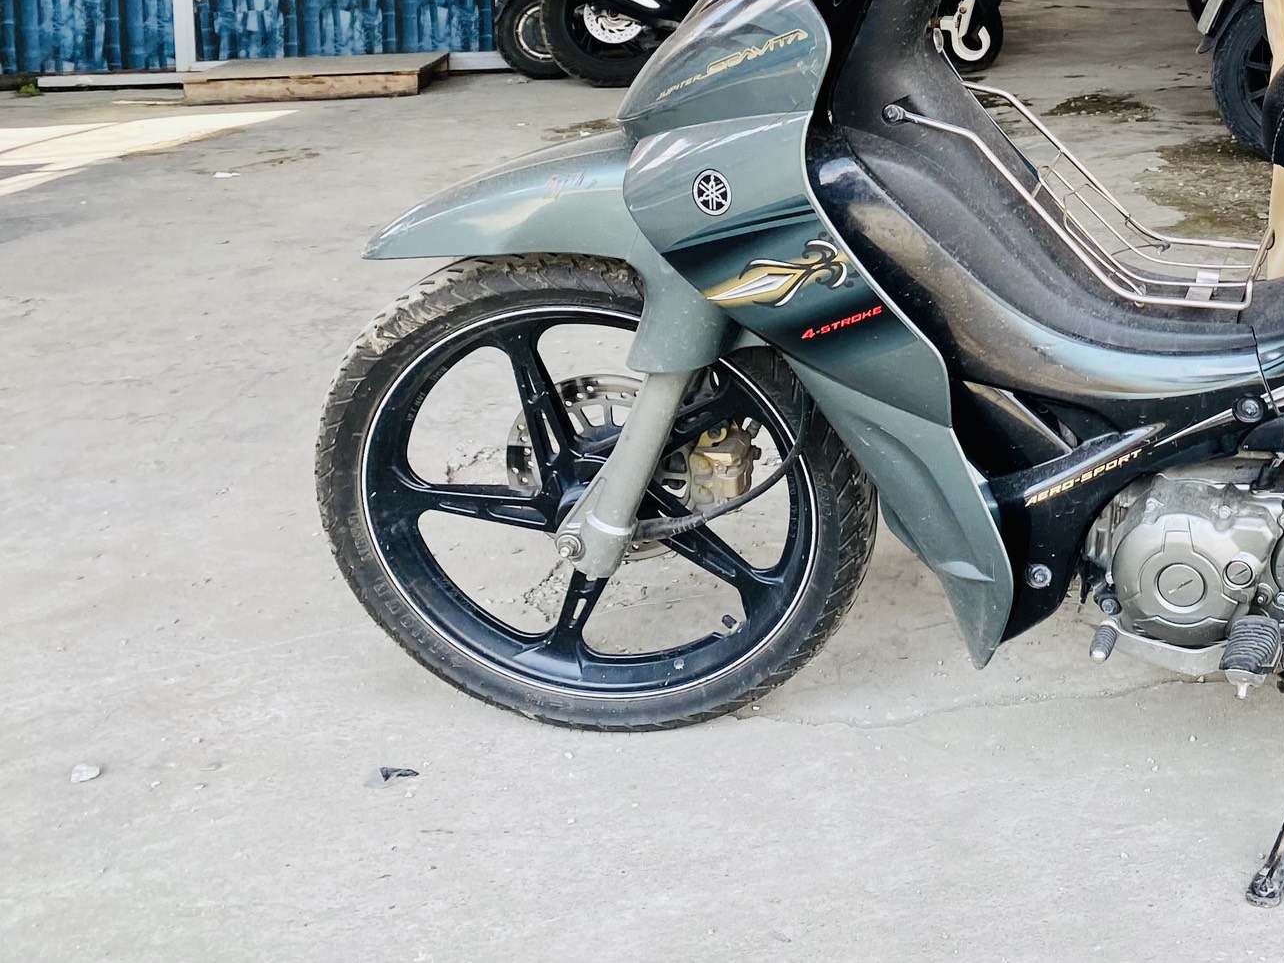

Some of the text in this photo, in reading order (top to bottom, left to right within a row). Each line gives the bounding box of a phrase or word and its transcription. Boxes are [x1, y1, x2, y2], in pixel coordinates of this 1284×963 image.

[656, 28, 809, 102] JUPITER GRAVITA
[801, 305, 883, 340] 4-STROKE
[1024, 448, 1143, 508] AERO-SPORT
